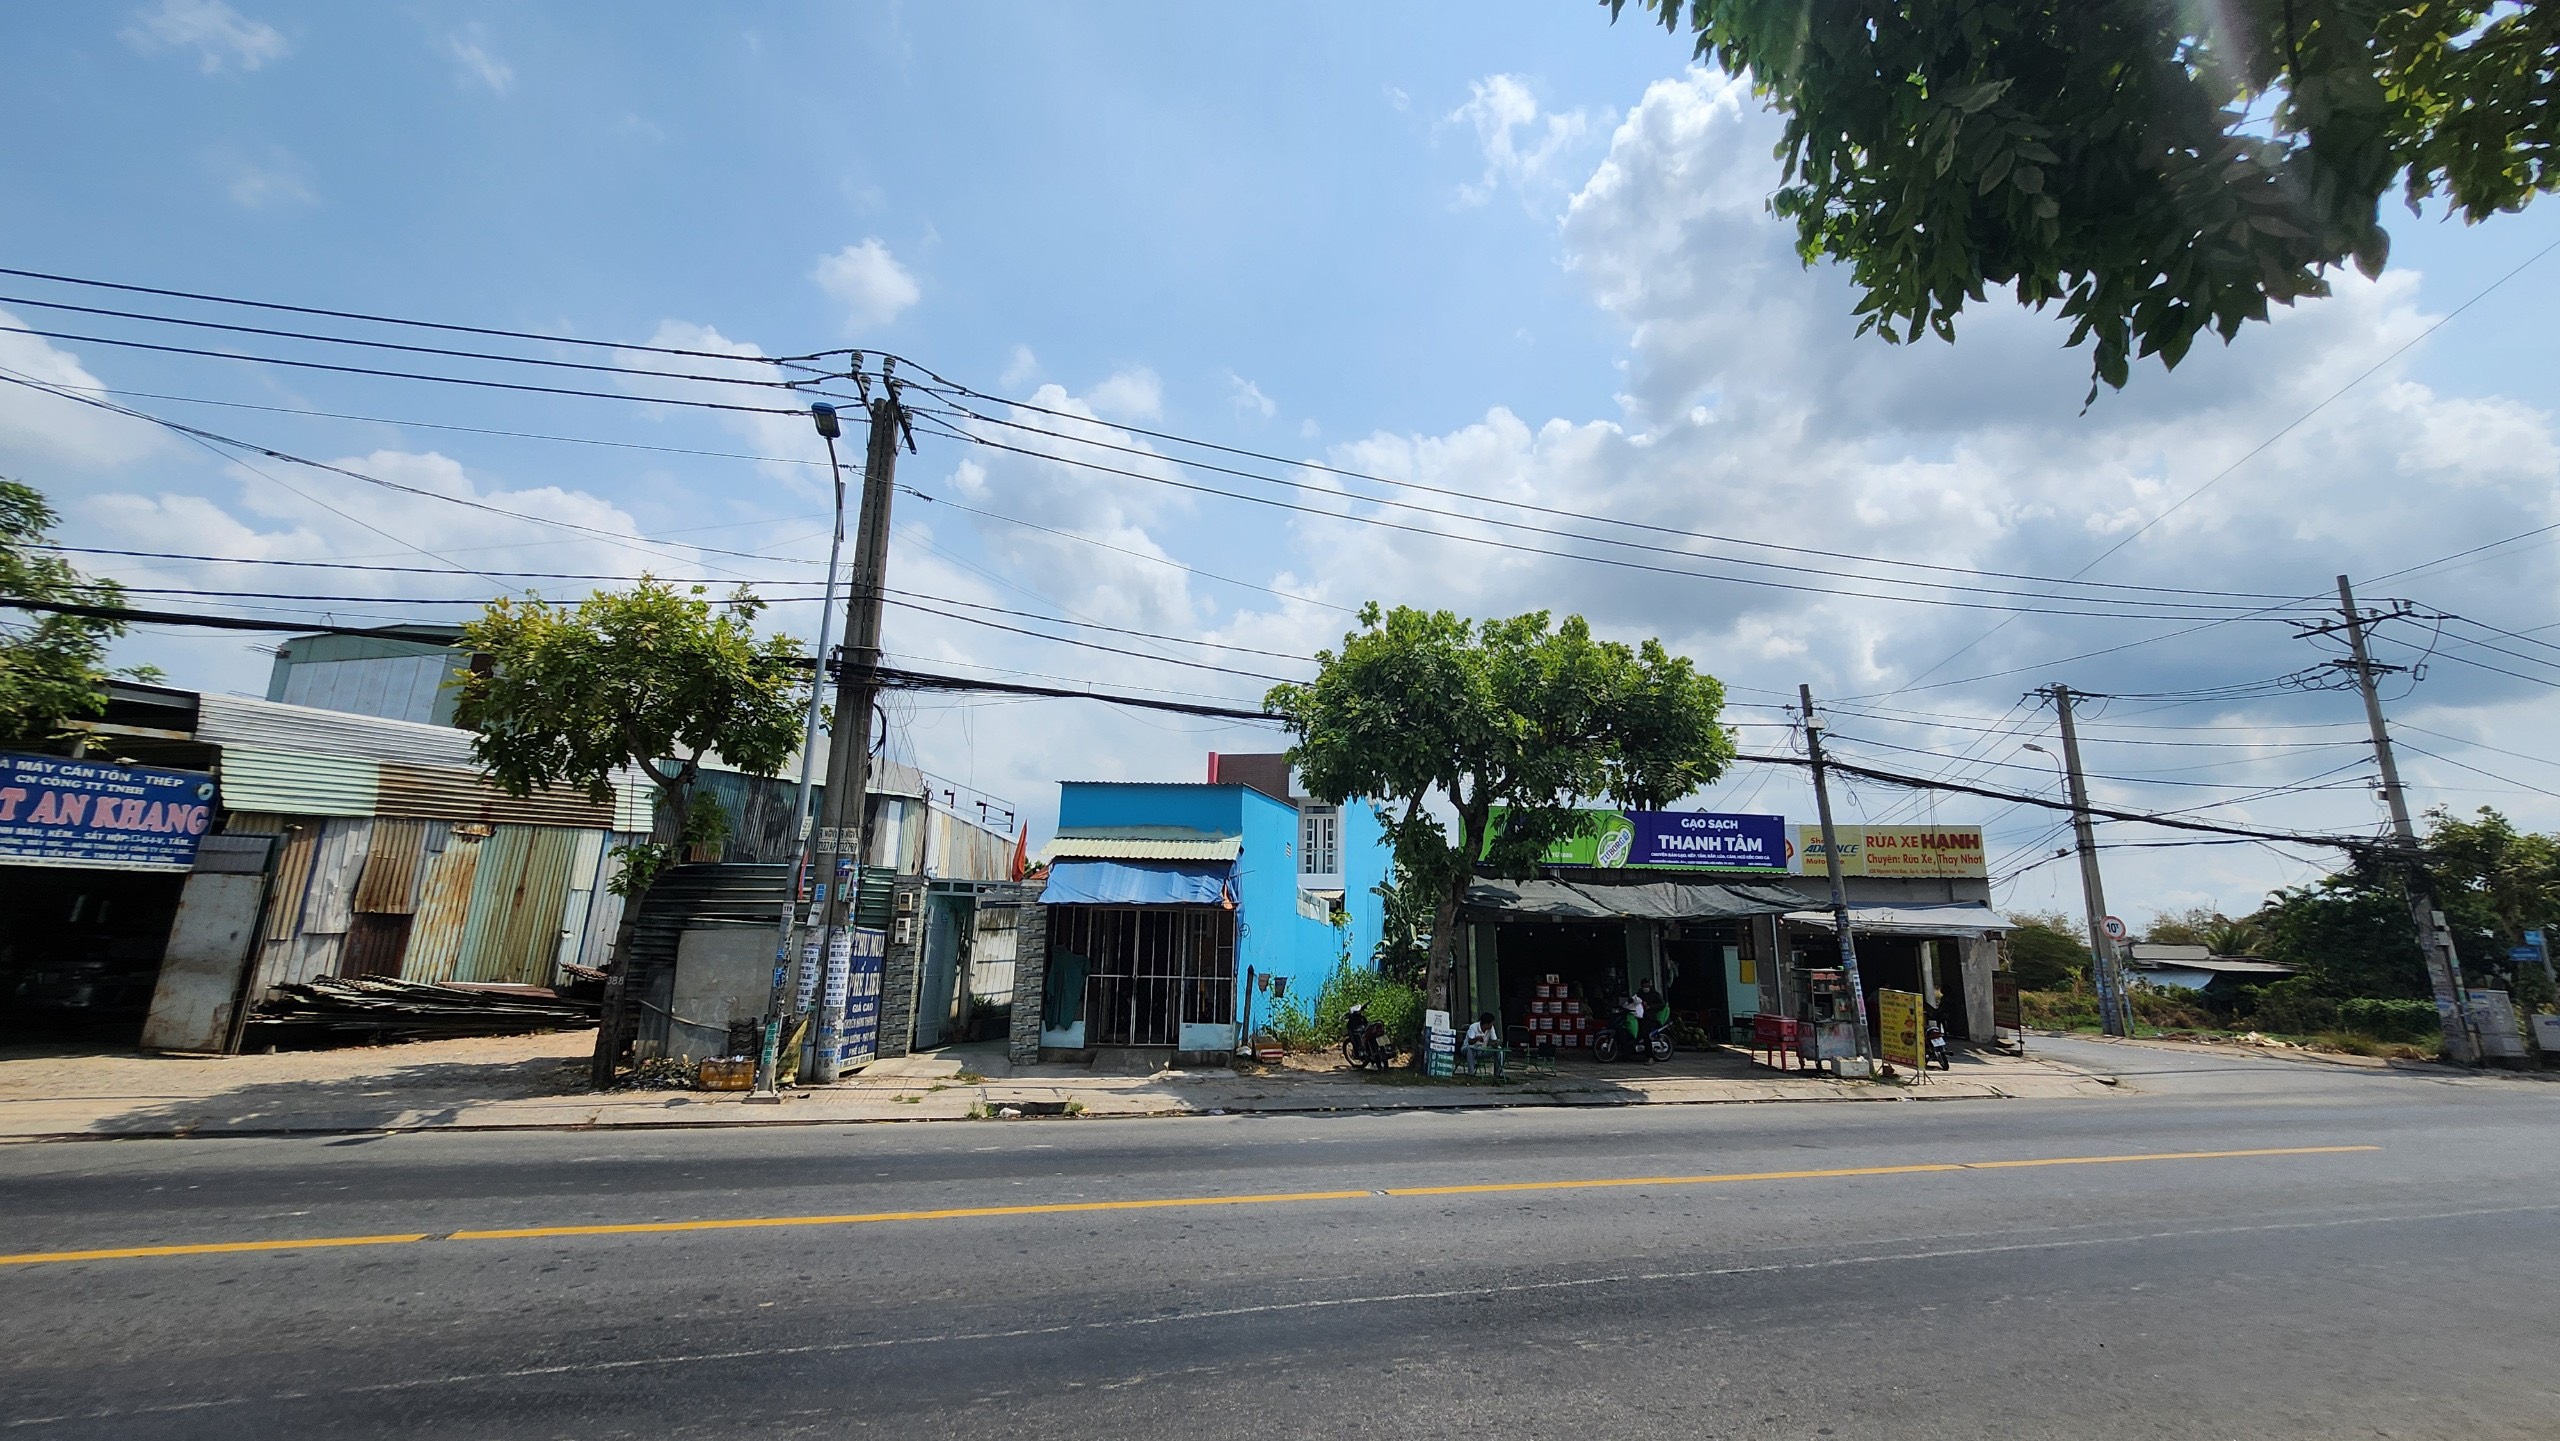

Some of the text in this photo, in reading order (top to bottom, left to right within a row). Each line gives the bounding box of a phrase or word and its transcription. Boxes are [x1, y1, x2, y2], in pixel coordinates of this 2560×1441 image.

[15, 774, 38, 784] CN
[40, 776, 82, 788] CÔNG
[84, 781, 104, 791] TY
[16, 760, 57, 773] MÁY
[60, 765, 95, 778] CÁN
[98, 769, 131, 782] TÔN
[145, 775, 184, 787] THÉP
[27, 790, 91, 826] AN
[90, 796, 209, 836] KHANG
[1680, 818, 1739, 832] GẠO SẠCH
[1600, 835, 1627, 864] TUBORG
[1658, 833, 1763, 852] THANH TÂM
[1866, 831, 1980, 851] RỬA XE HẠNH
[1867, 853, 1901, 866] Chuyên:
[1938, 853, 1959, 866] Thay
[853, 932, 871, 957] THU
